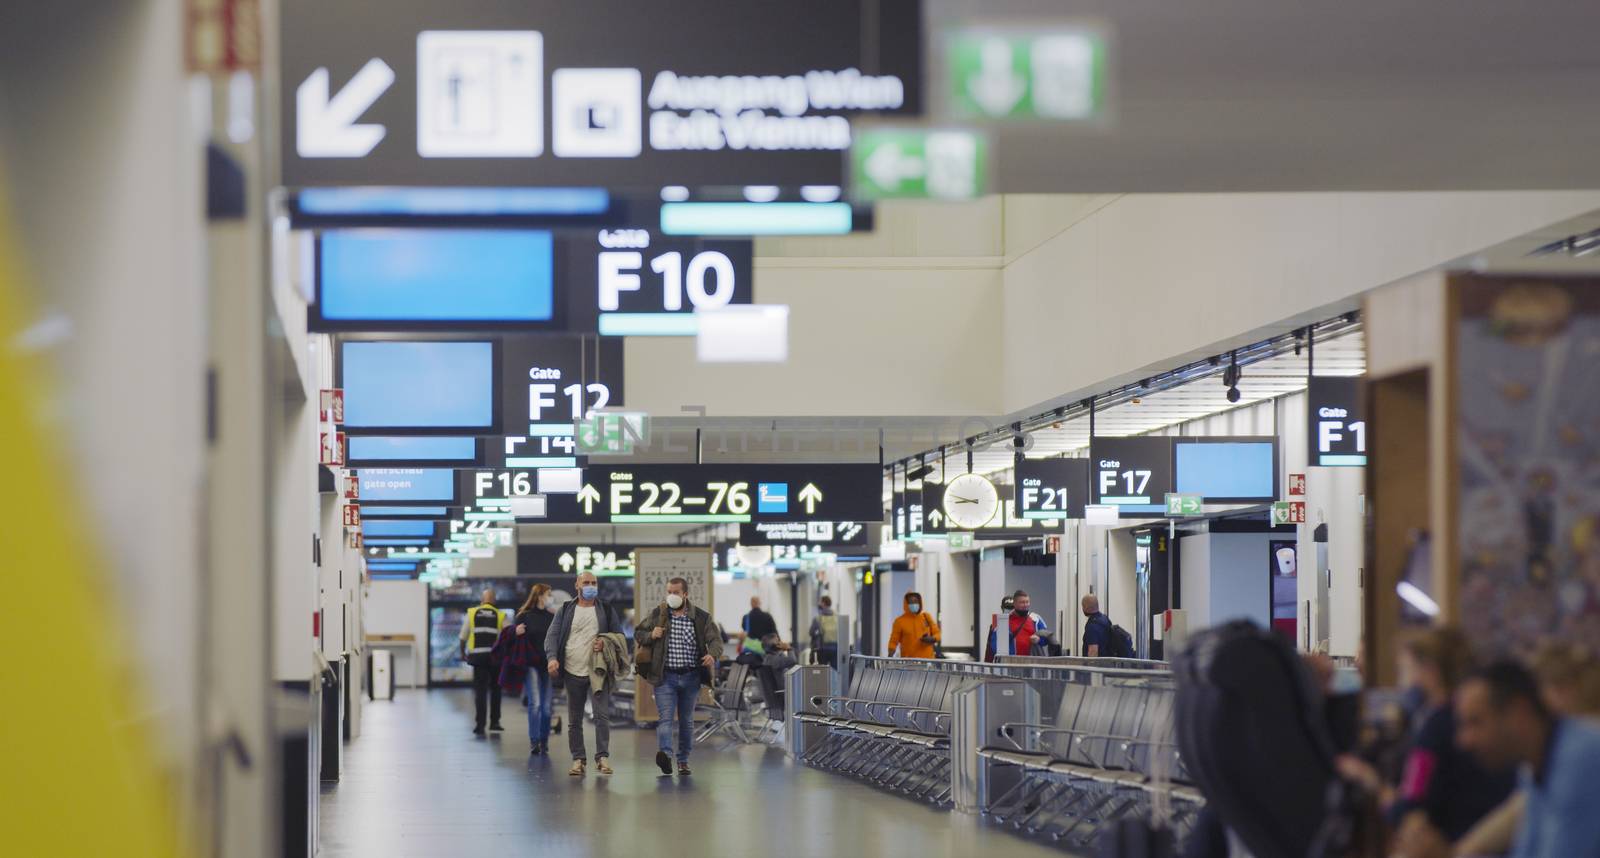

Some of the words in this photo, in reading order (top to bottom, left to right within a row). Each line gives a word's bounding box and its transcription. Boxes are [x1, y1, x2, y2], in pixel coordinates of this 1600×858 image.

[649, 70, 808, 116] Ausgang
[804, 67, 903, 109] Wien
[650, 110, 725, 150] Exit
[721, 109, 850, 150] Vienna
[529, 367, 561, 380] Gate
[1319, 407, 1348, 418] Gate
[1100, 459, 1121, 468] Gate
[610, 472, 633, 481] Gates
[1022, 478, 1042, 487] Gate
